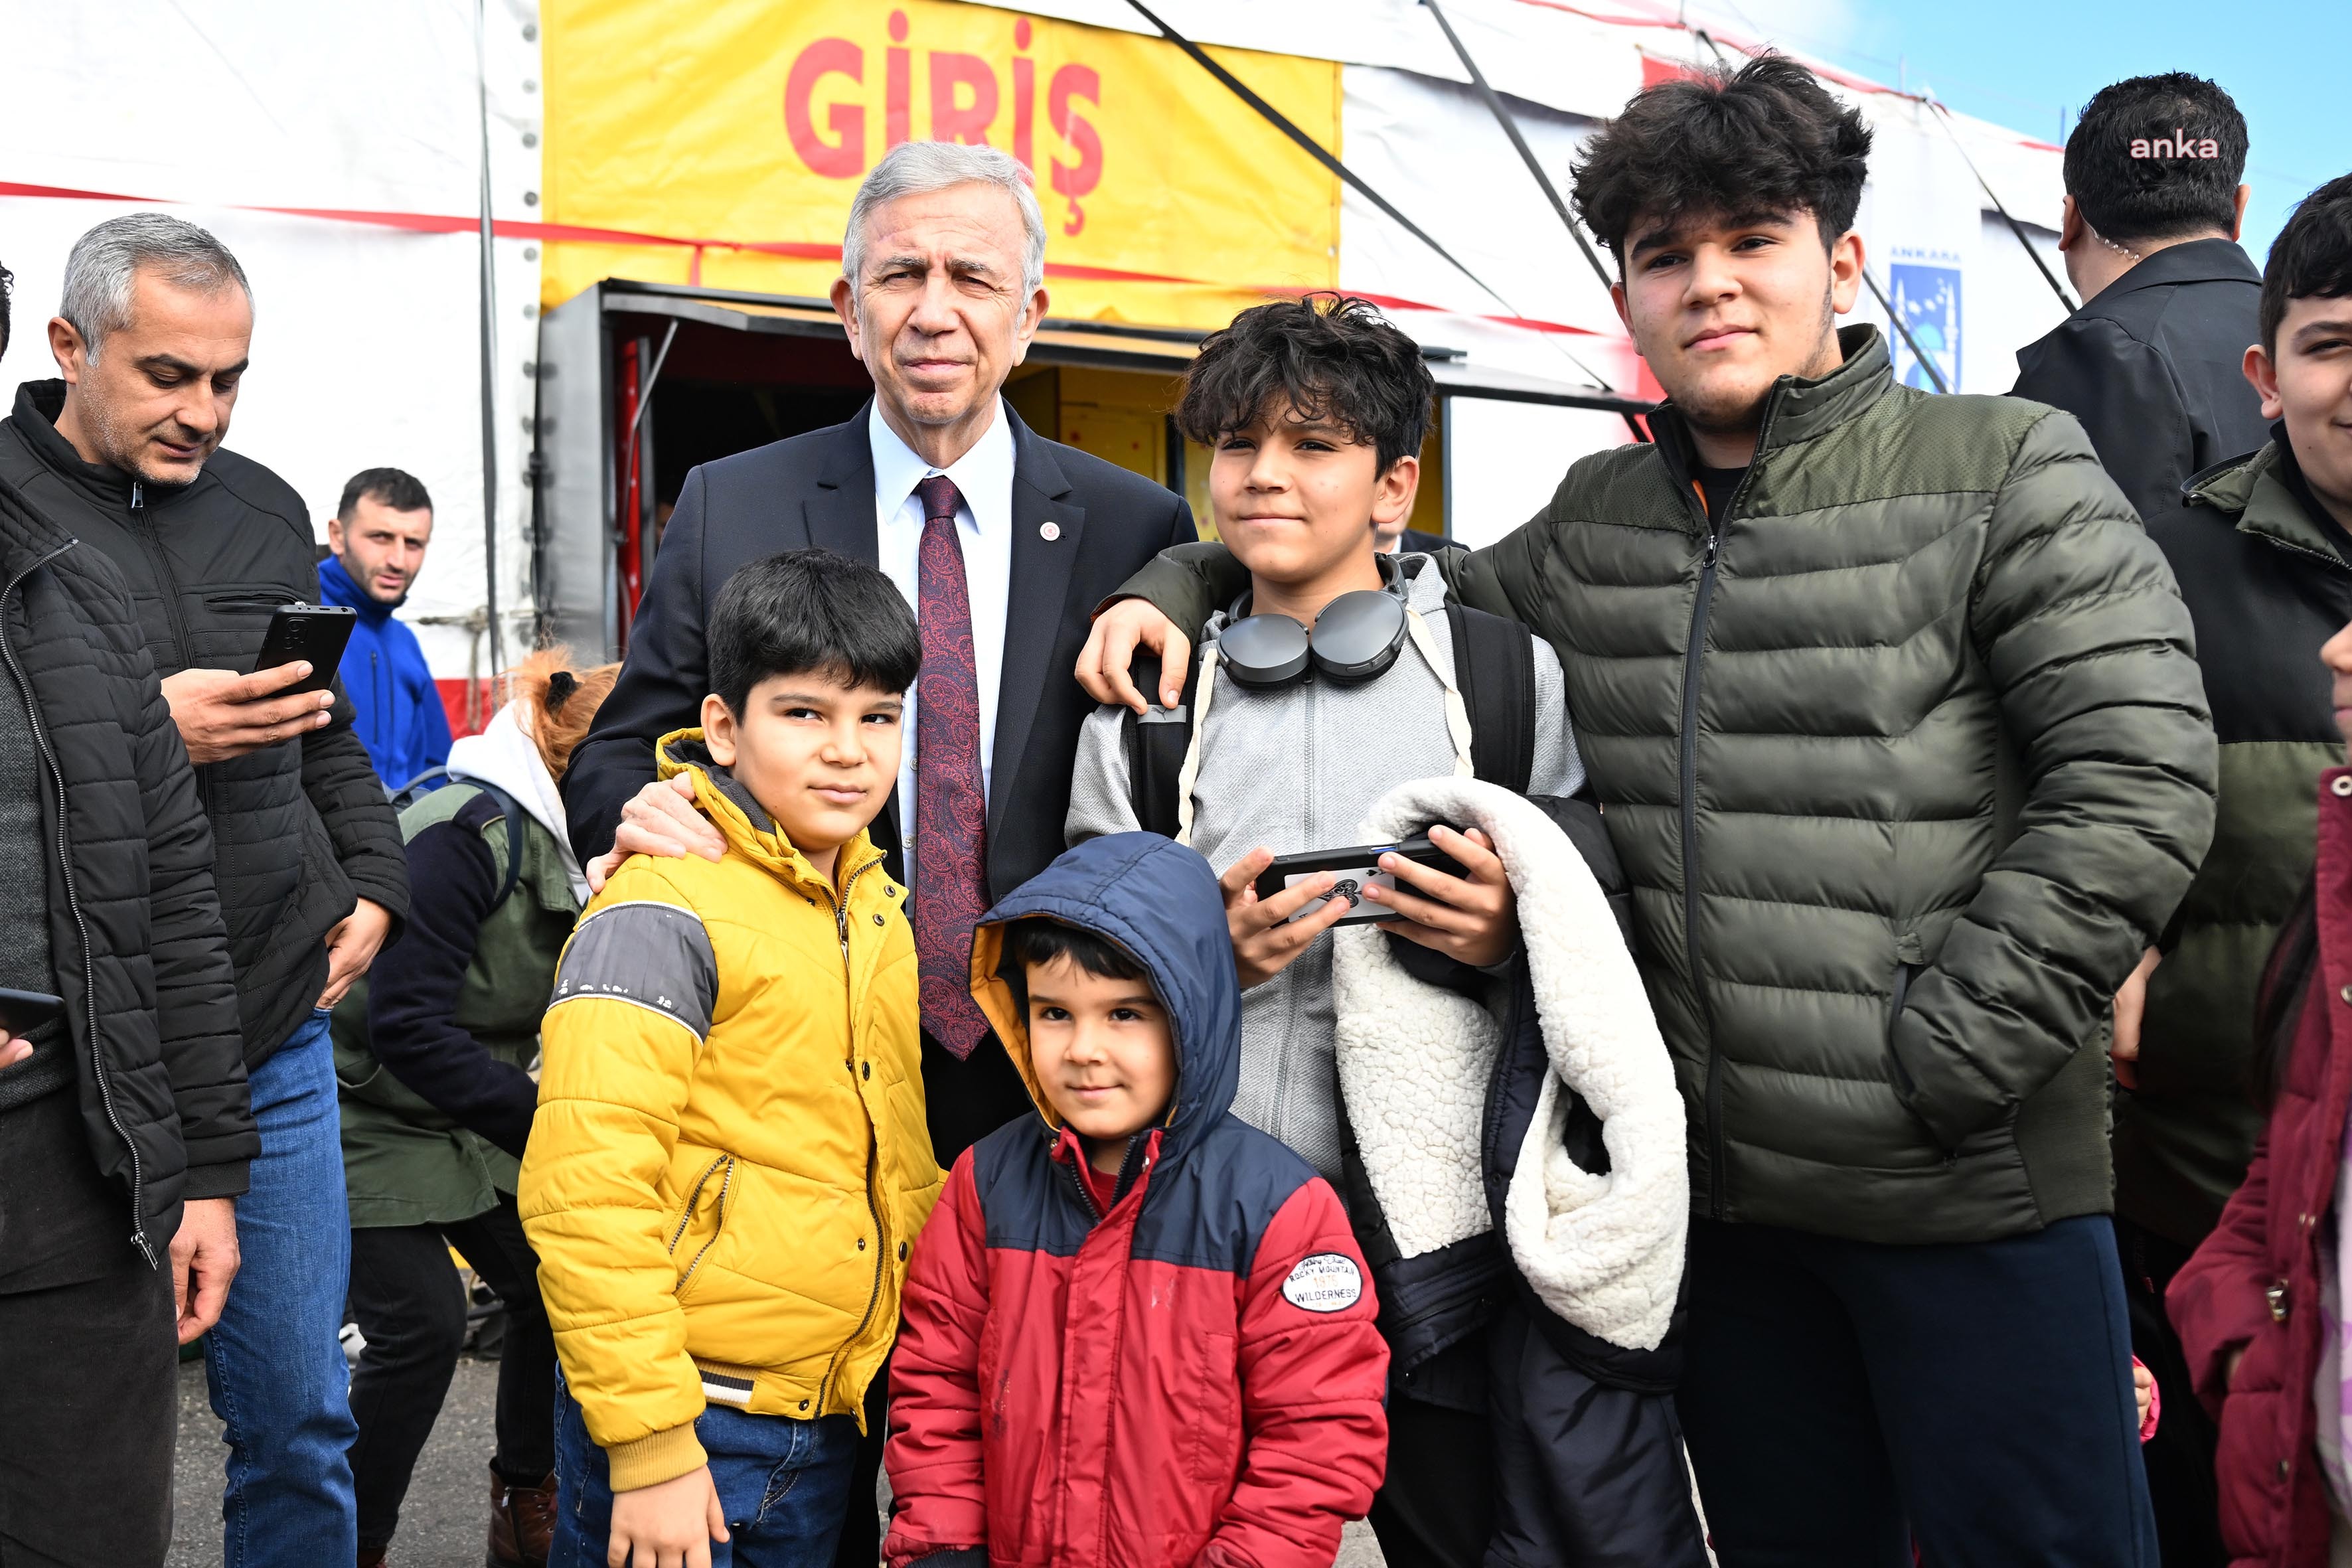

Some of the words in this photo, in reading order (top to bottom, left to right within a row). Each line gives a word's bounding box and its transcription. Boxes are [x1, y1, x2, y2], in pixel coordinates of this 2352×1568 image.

[785, 10, 1103, 236] GİRİŞ
[1891, 246, 1960, 262] ANKARA
[1289, 1269, 1314, 1283] ROCKY
[1318, 1266, 1354, 1275] MOUNTAIN
[1295, 1289, 1356, 1302] WILDERNESS
